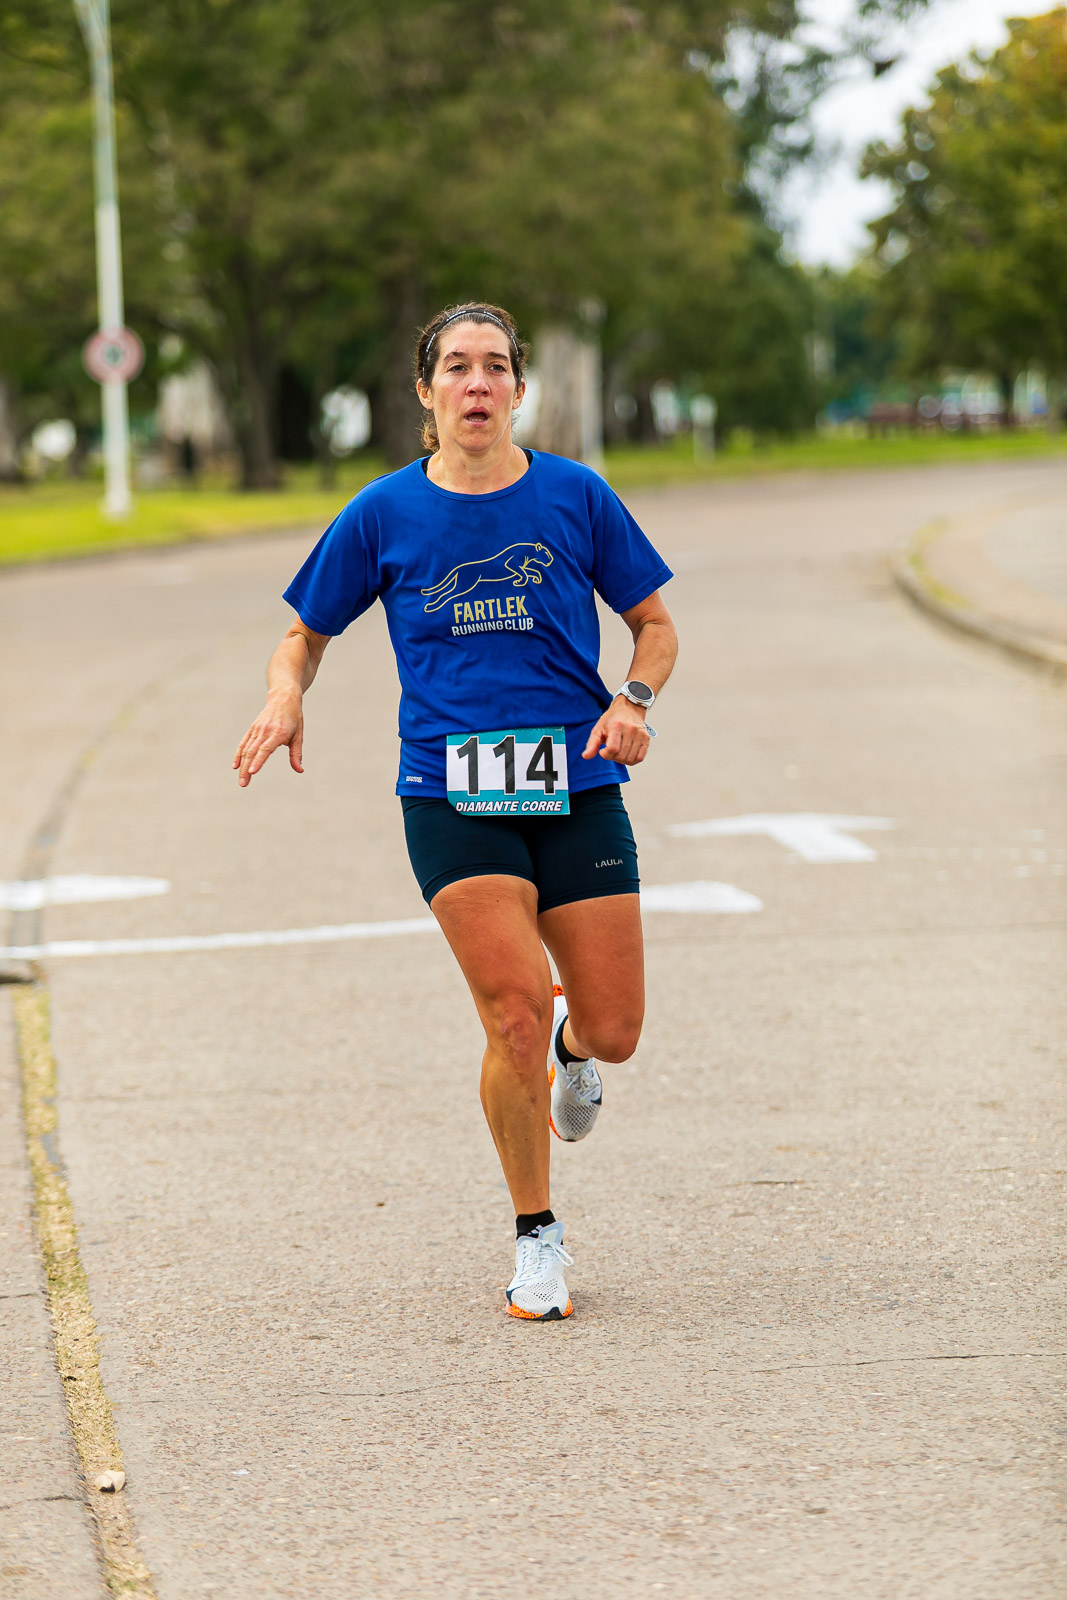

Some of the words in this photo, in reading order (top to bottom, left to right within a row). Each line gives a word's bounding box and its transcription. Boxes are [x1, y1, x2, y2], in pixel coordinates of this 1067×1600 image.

[453, 596, 529, 624] FARTLEK
[451, 620, 504, 637] RUNNING
[504, 617, 534, 631] CLUB
[456, 735, 559, 795] 114
[455, 800, 518, 812] DIAMANTE
[521, 800, 563, 812] CORRE
